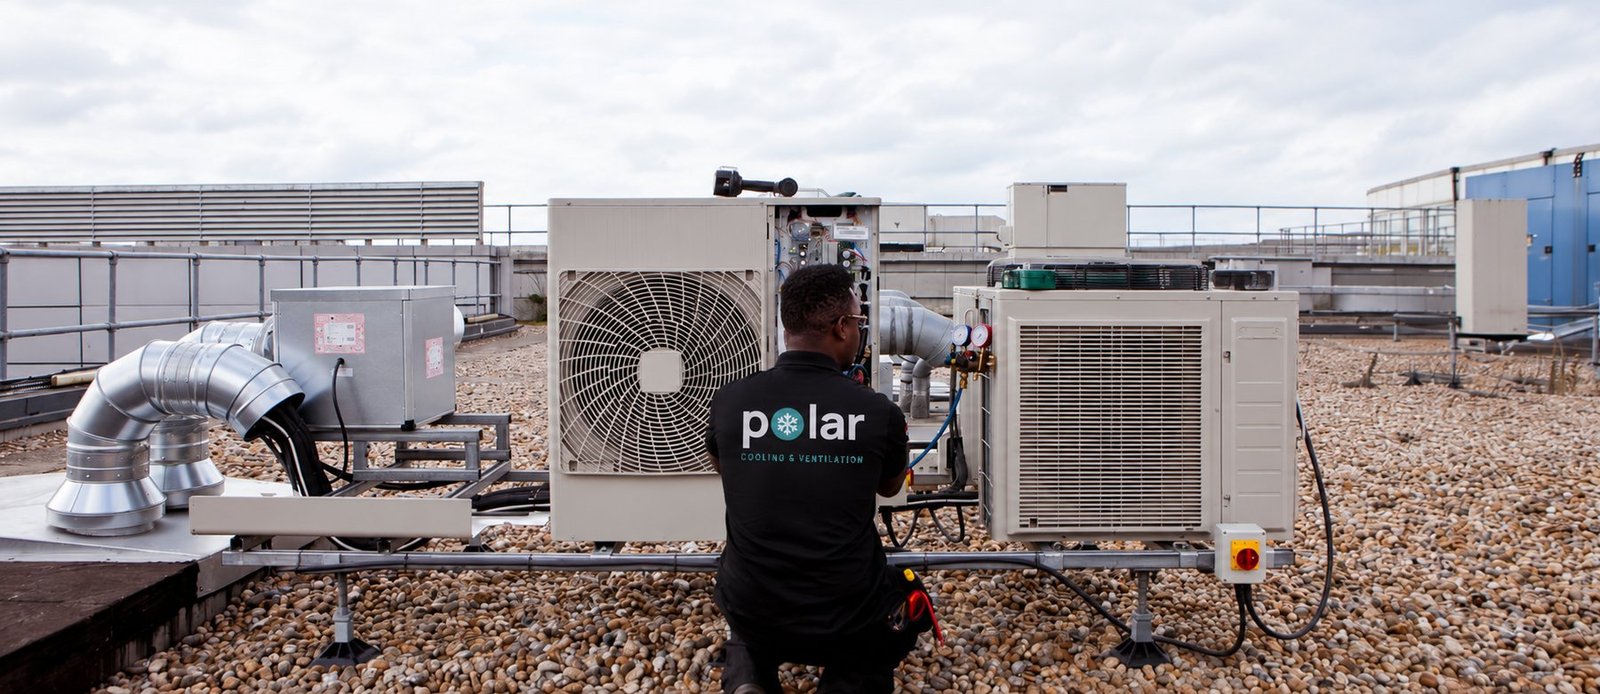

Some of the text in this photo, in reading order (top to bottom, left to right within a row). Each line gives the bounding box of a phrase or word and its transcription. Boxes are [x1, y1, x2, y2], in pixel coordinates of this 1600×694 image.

[742, 403, 865, 449] polar
[740, 453, 864, 464] COOLING & VENTILATION
